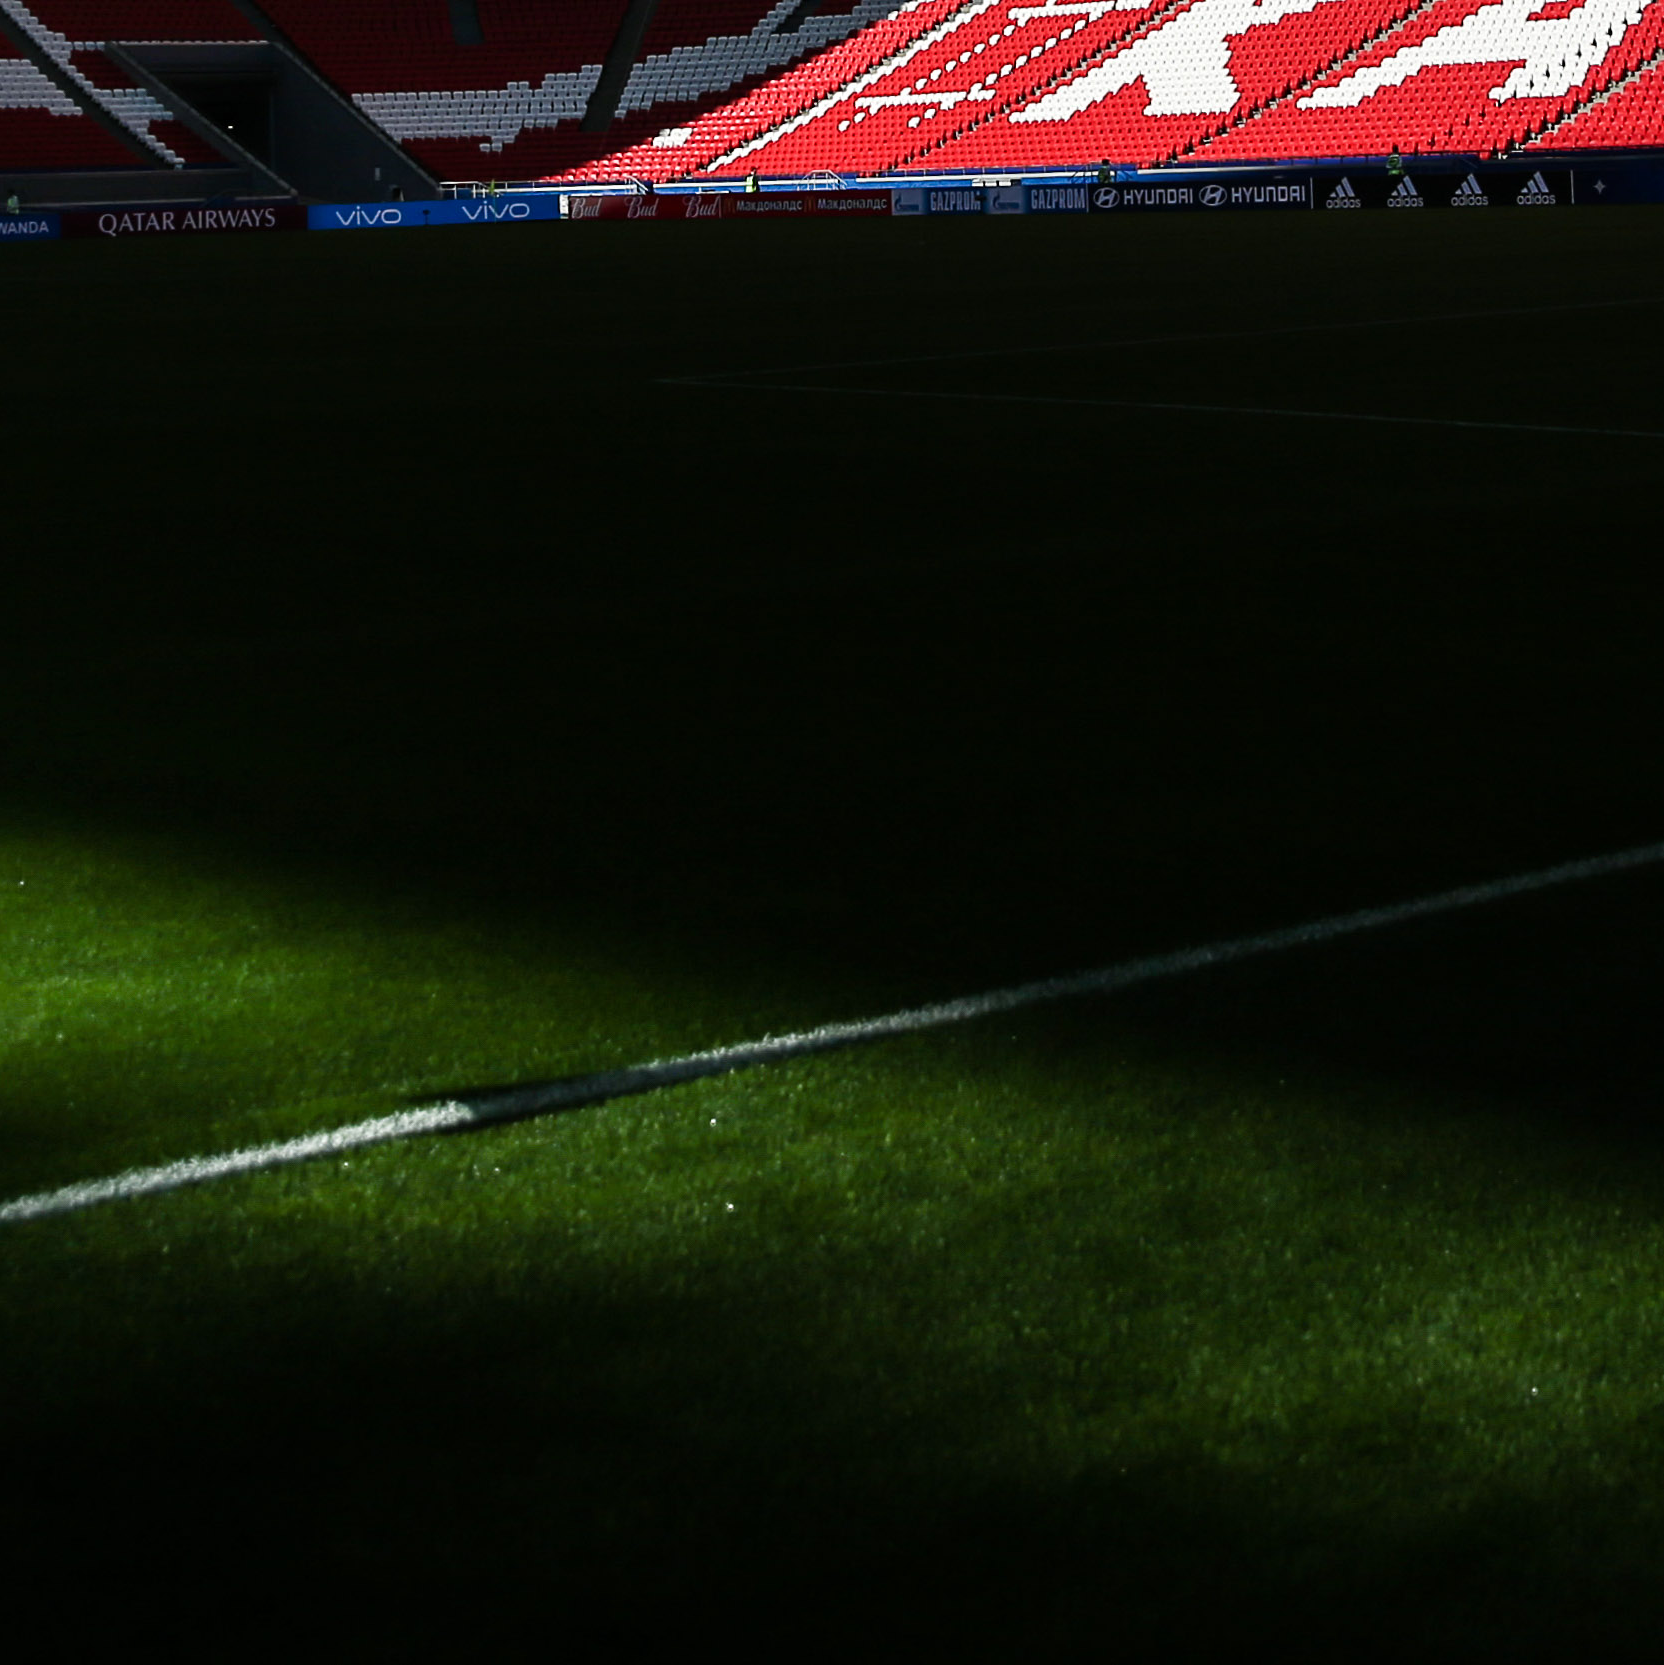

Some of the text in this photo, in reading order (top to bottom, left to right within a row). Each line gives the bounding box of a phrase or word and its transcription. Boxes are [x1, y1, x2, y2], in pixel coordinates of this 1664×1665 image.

[572, 195, 721, 219] Bud Bud Bud
[736, 197, 888, 213] Макдоналдс Макдоналдс
[929, 185, 1086, 211] GAZPROM GAZPROM
[1123, 184, 1307, 207] HYUNDAI HYUNDAI
[1325, 193, 1556, 210] adidas adidas adidas adidas
[98, 208, 277, 235] QATAR AIRWAYS
[335, 199, 531, 226] vivo vivo
